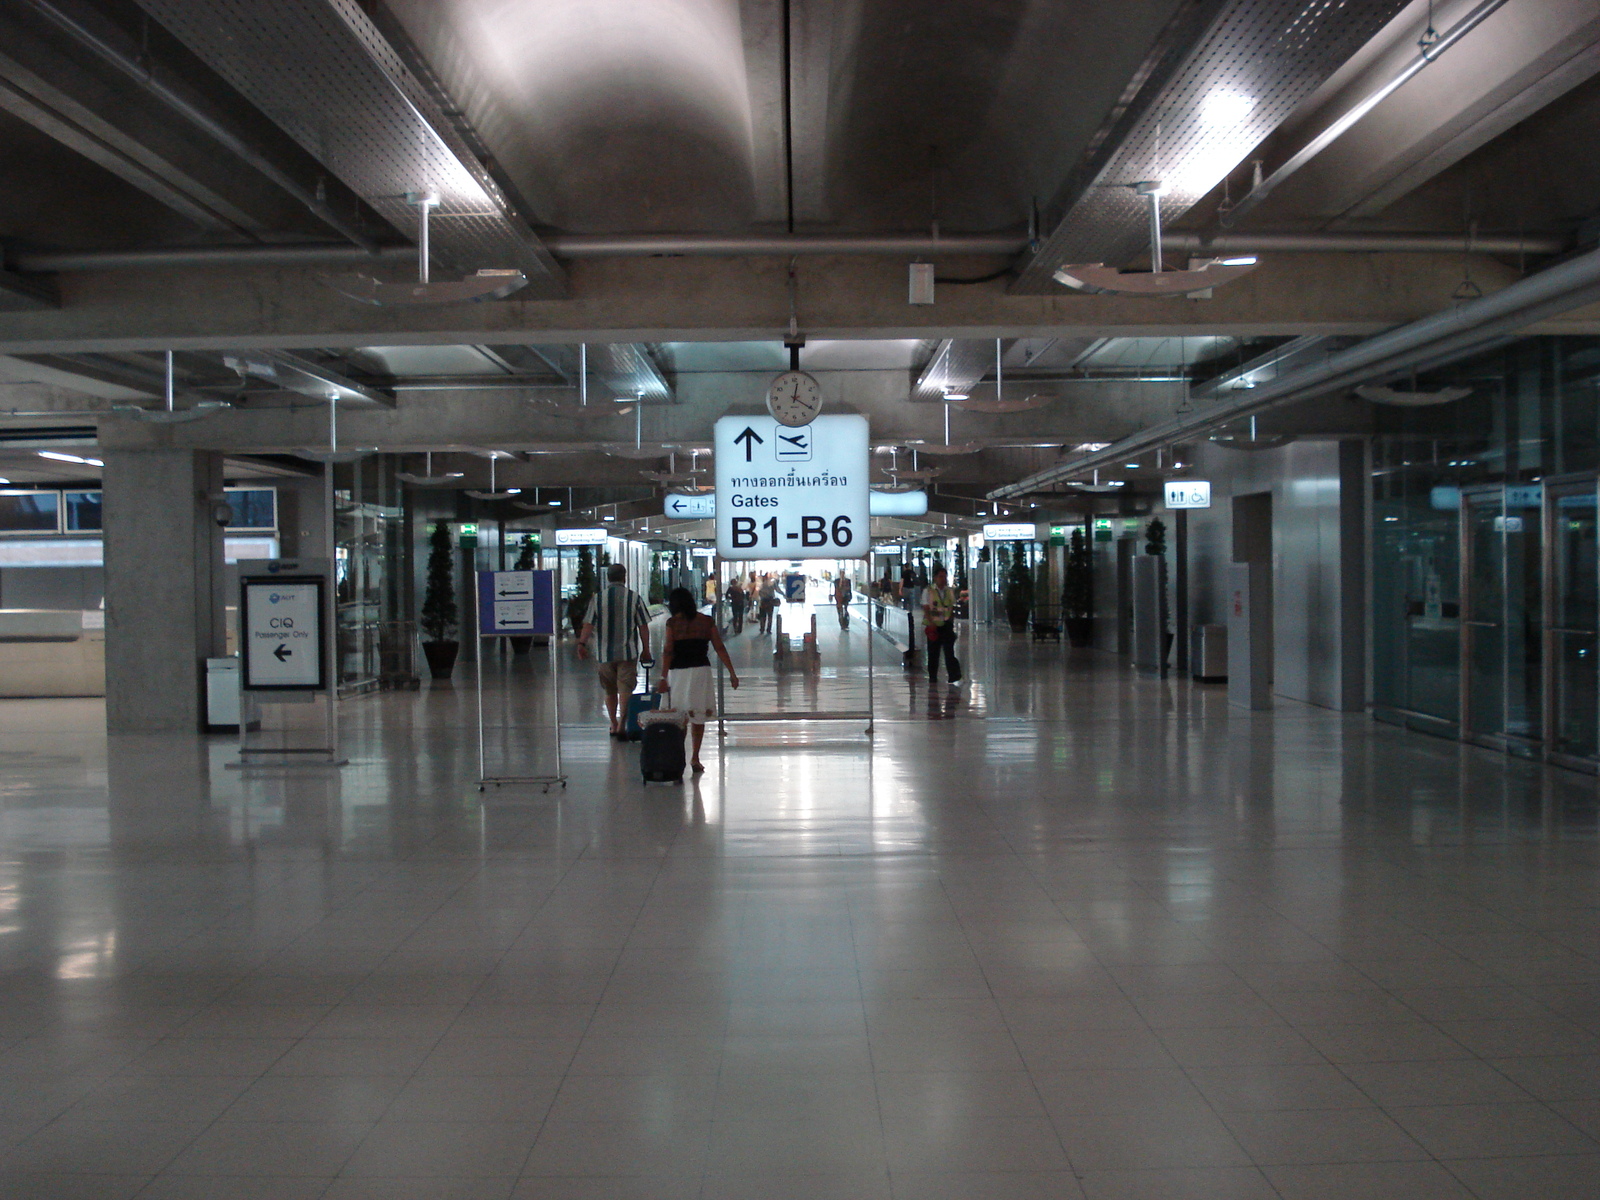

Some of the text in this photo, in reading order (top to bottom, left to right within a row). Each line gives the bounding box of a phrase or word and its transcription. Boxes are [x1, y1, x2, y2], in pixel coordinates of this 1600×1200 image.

[731, 467, 847, 487] ทางออกขึ้นเครื่อง
[731, 494, 779, 508] Gates
[731, 515, 853, 549] B1-B6
[791, 579, 806, 600] 2
[269, 617, 294, 629] CIQ
[255, 631, 308, 640] Passenger Only
